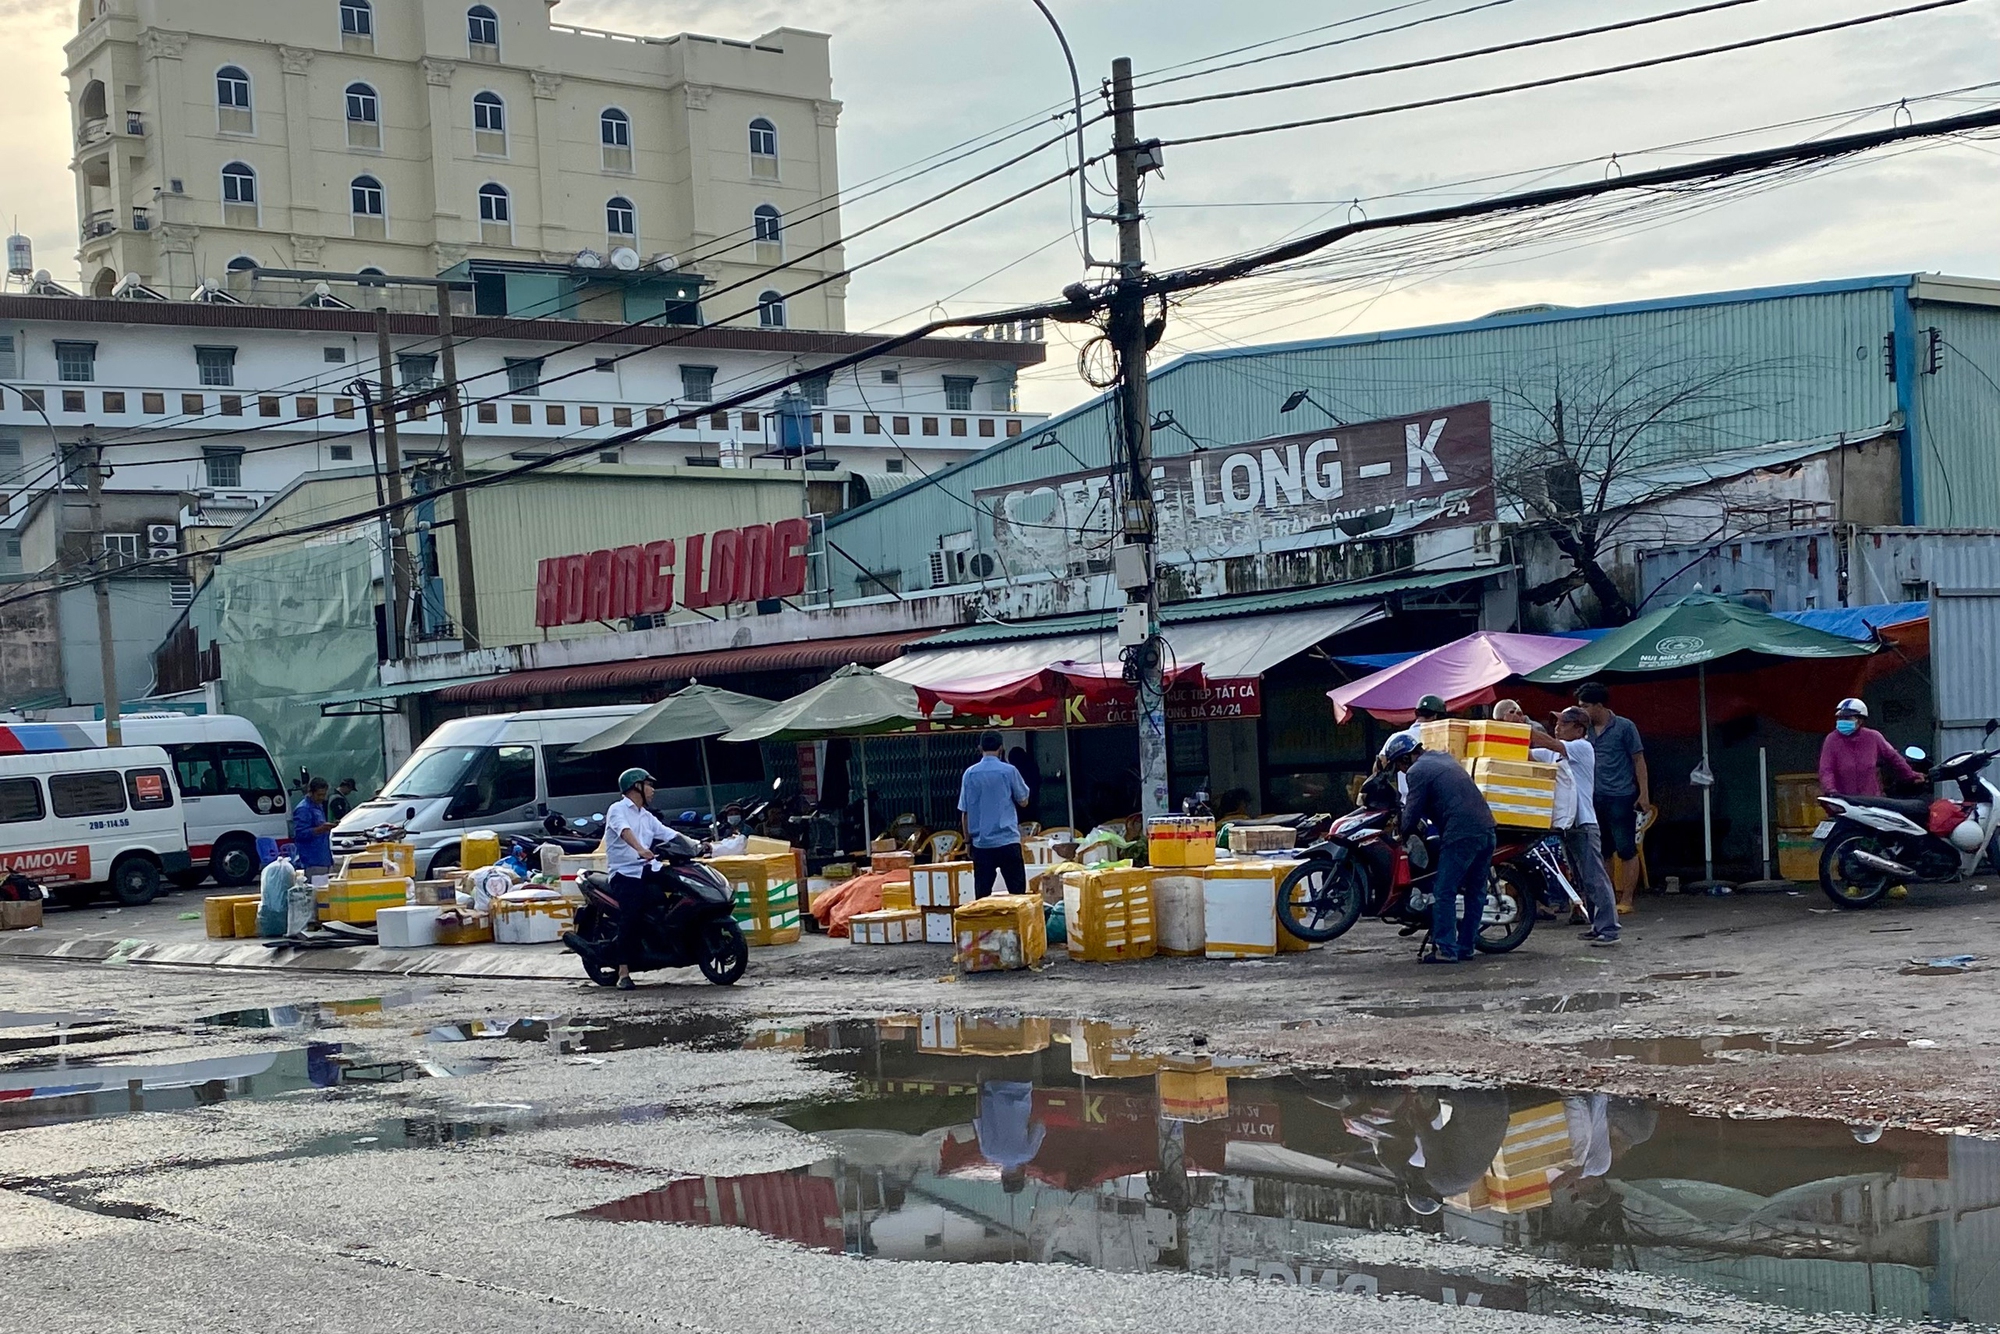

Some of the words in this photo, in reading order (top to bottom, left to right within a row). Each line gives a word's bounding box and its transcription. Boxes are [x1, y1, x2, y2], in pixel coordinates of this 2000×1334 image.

[1189, 437, 1343, 519] LONG
[1405, 418, 1449, 487] K
[685, 518, 809, 608] LONG
[1065, 695, 1087, 723] K
[1210, 703, 1241, 716] 24/24
